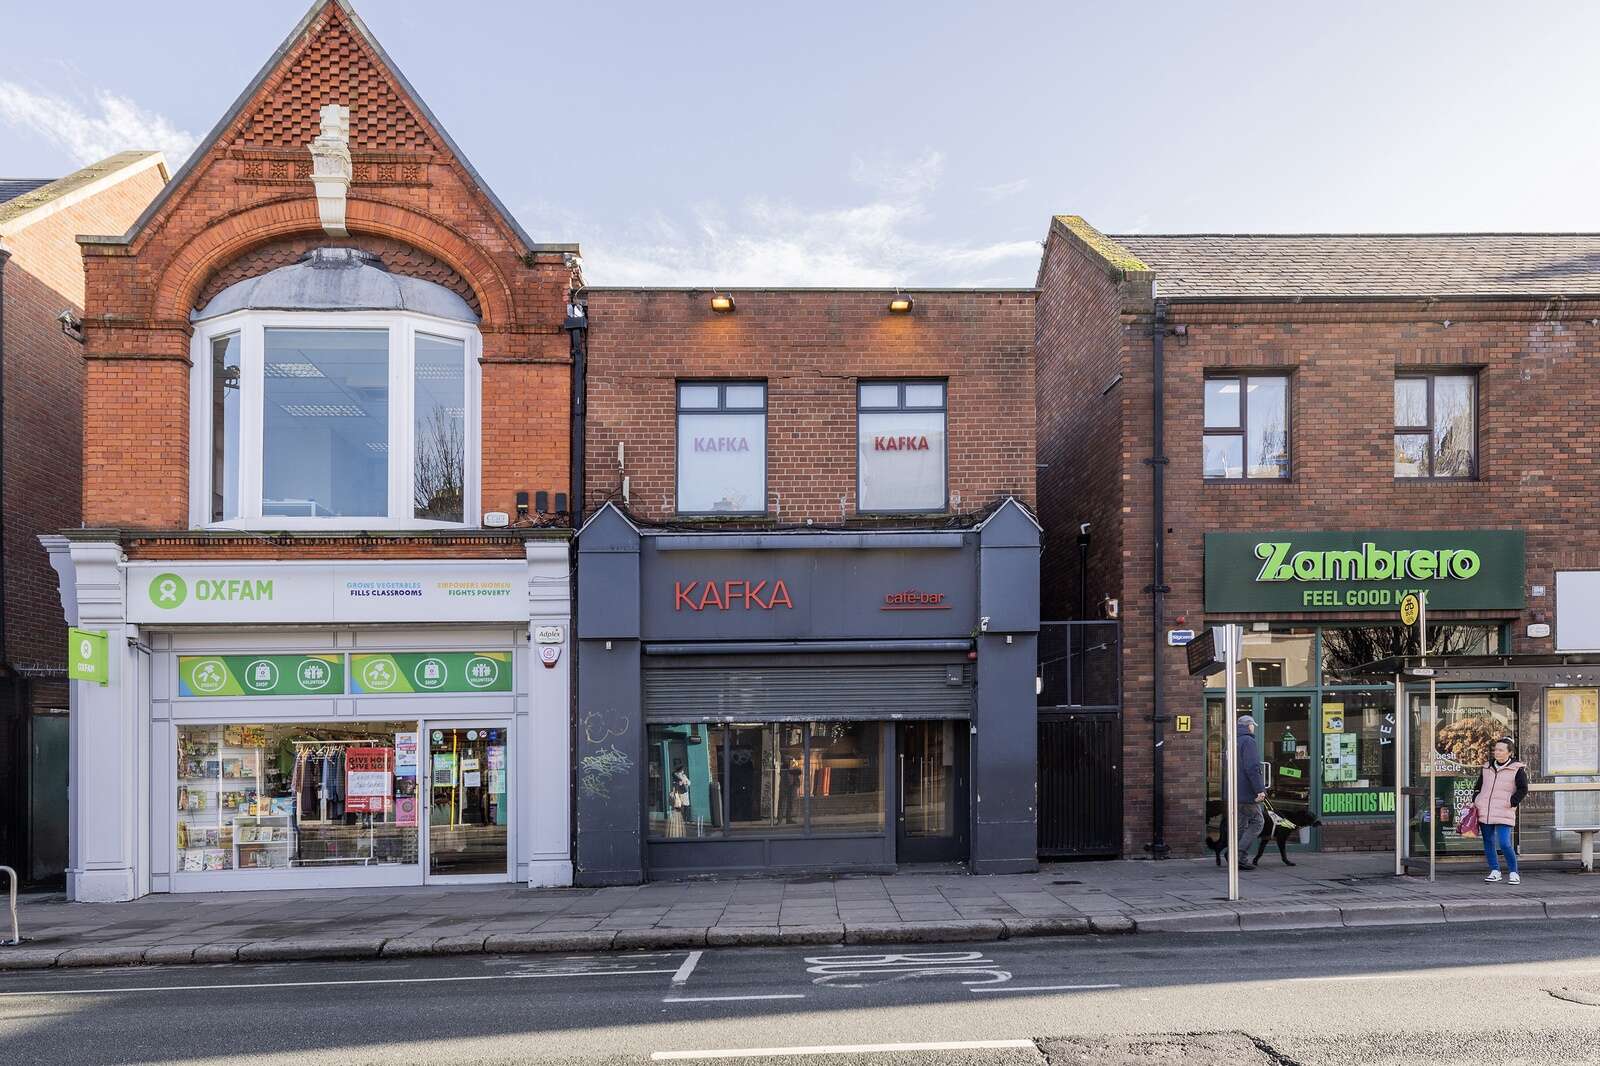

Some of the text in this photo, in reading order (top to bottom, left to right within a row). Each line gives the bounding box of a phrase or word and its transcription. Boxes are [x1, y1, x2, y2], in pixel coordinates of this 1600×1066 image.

[694, 437, 750, 451] KAFKA
[874, 435, 929, 451] KAFKA
[1254, 542, 1481, 581] Zambrero
[194, 579, 274, 601] OXFAM
[675, 579, 793, 610] KAFKA
[1303, 589, 1343, 606] FEEL
[1346, 589, 1390, 605] GOOD
[1178, 717, 1189, 730] H
[1454, 780, 1475, 790] NEW
[1322, 792, 1377, 812] BURRITOS
